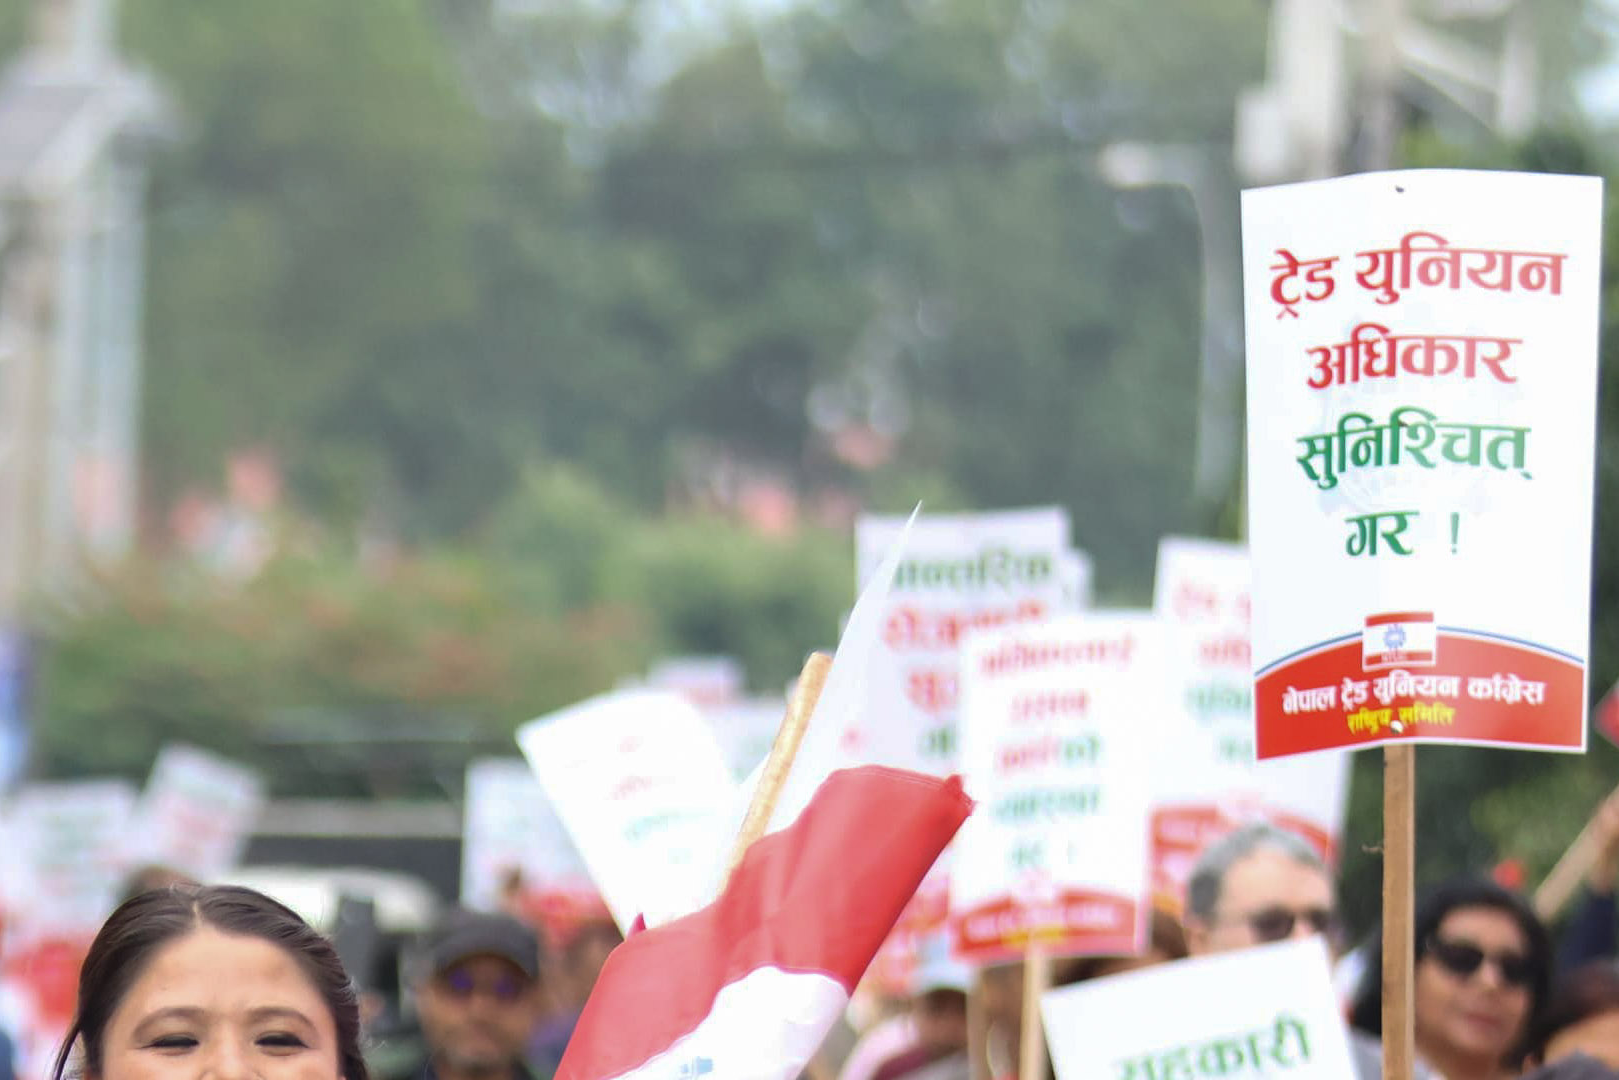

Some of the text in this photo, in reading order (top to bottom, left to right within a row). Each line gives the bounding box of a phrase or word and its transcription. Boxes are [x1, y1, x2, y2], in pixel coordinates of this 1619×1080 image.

[1269, 232, 1569, 320] ट्रेड युनियन
[1305, 322, 1523, 391] अधिकार
[1296, 405, 1533, 490] सुनिश्चित्
[1344, 510, 1460, 557] गर !
[1282, 685, 1337, 714] नेपाल
[1340, 677, 1370, 710] ट्रेड
[1373, 669, 1461, 704] युनियन
